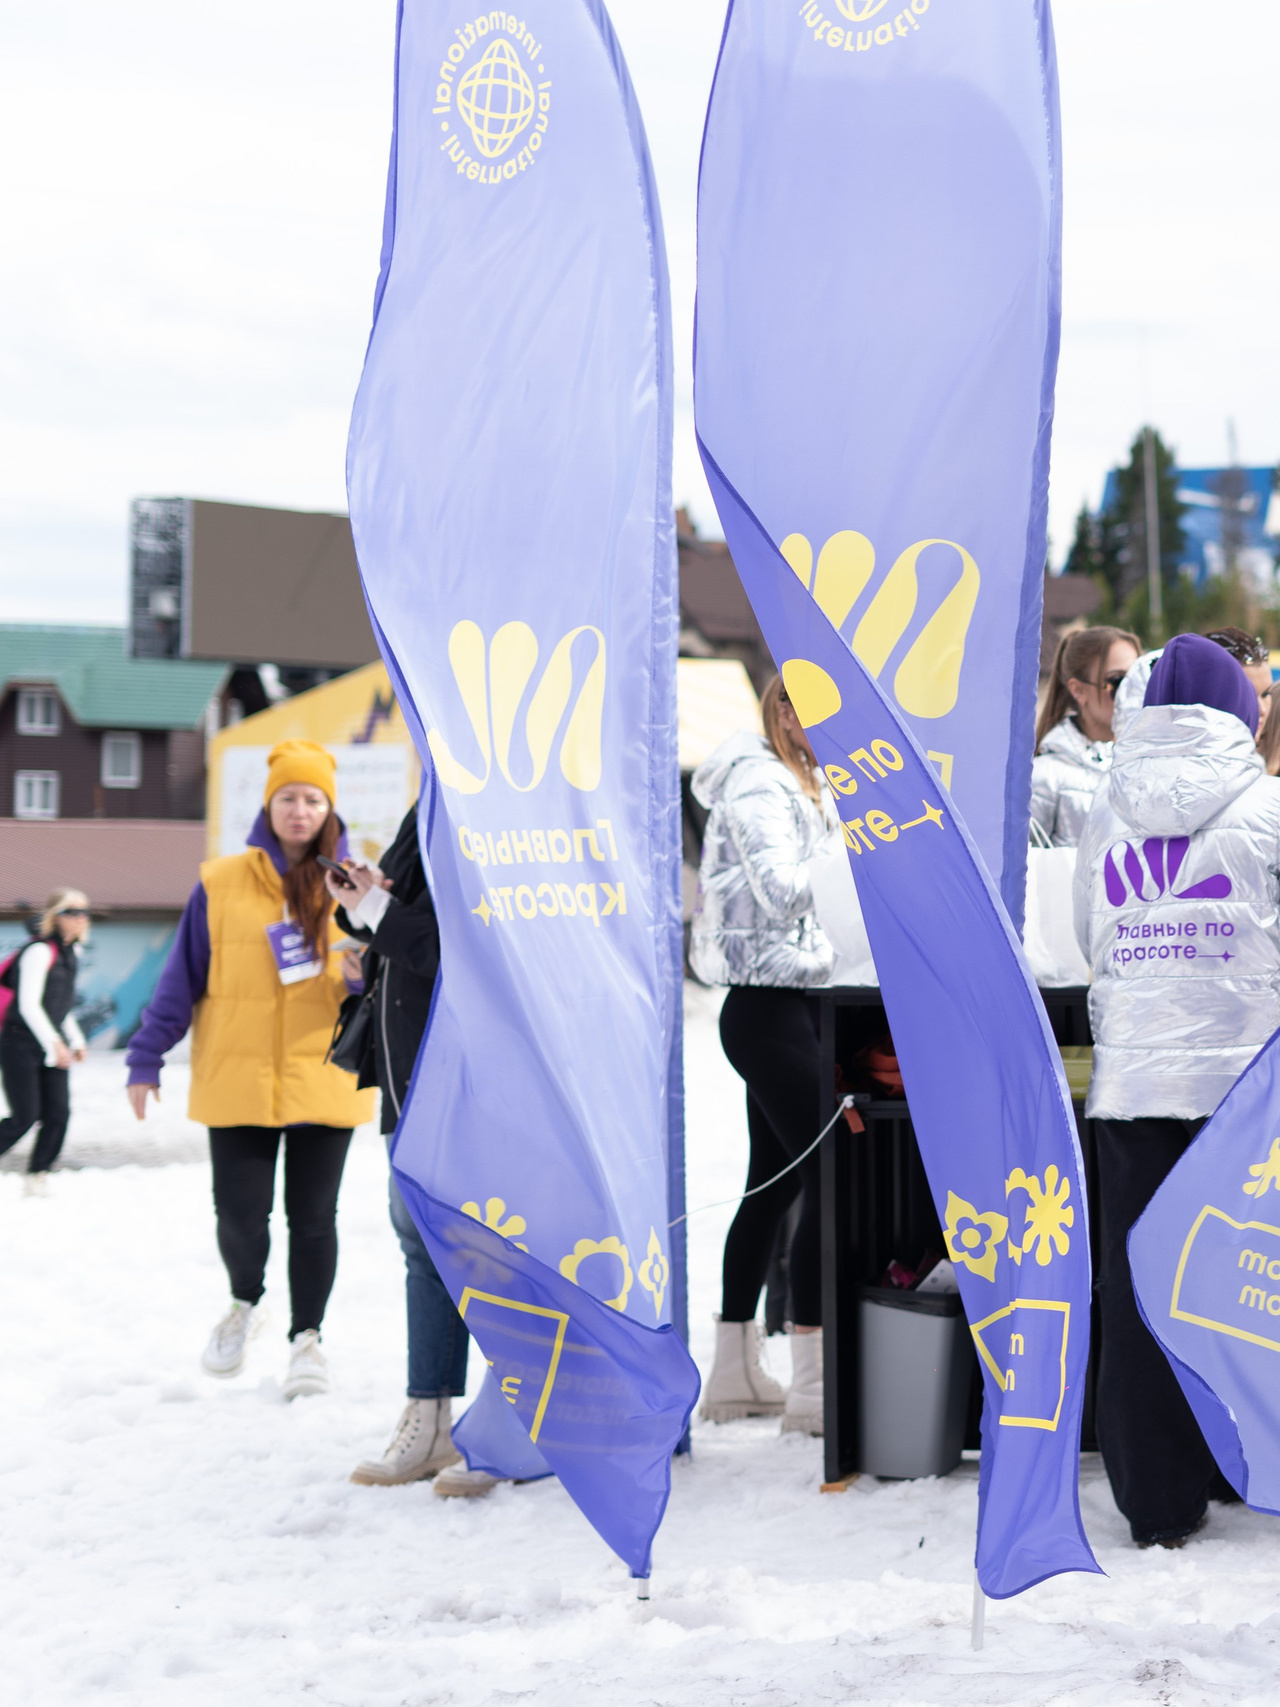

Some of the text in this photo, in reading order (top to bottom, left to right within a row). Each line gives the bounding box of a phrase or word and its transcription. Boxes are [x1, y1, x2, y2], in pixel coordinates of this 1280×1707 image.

[848, 739, 904, 783] по
[1205, 922, 1235, 937] по
[1112, 945, 1197, 966] красоте
